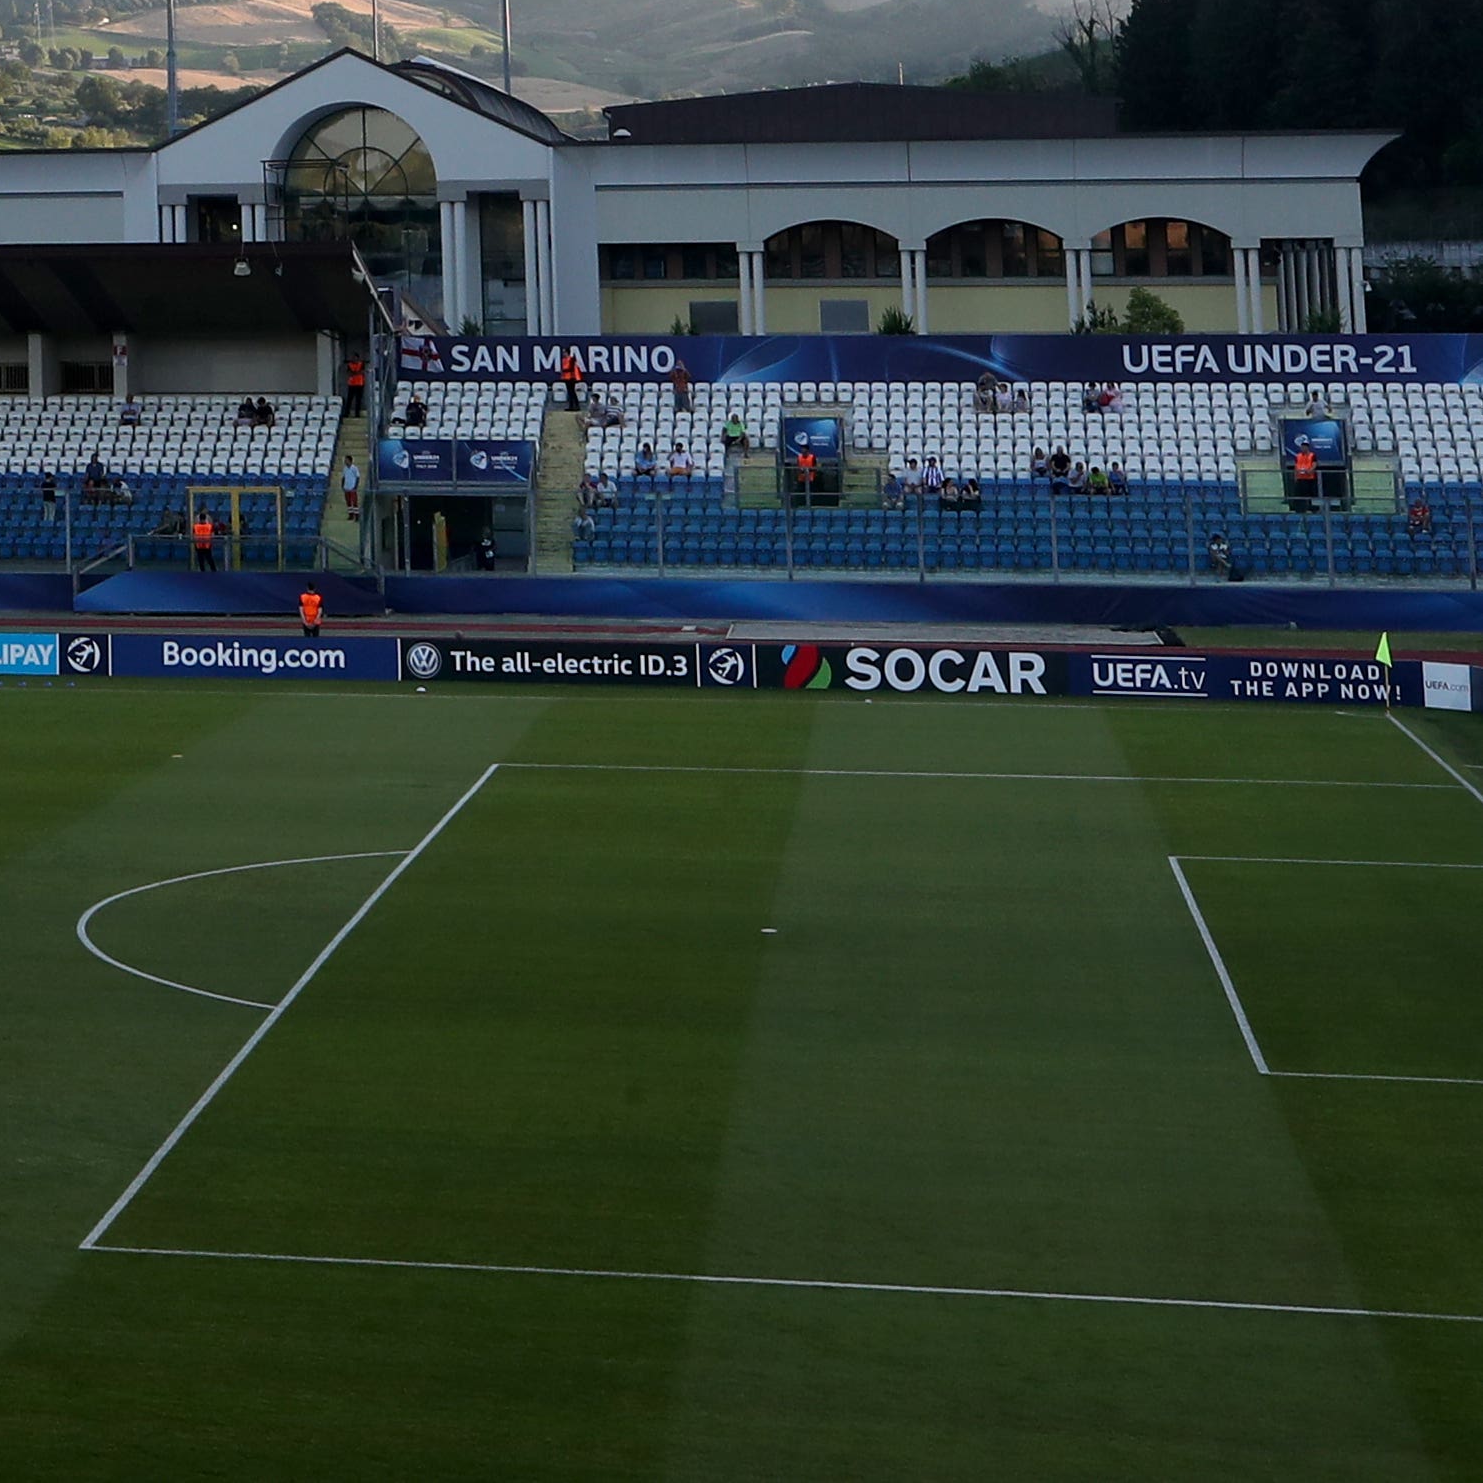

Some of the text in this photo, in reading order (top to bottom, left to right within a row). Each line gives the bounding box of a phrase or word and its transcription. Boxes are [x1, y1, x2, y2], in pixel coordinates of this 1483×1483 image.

[450, 344, 676, 374] SAN MARINO
[1121, 344, 1417, 374] UEFA UNDER-21
[162, 641, 346, 674] Booking.com
[449, 651, 688, 676] The all-electric ID.3
[844, 647, 1047, 696] SOCAR
[1249, 661, 1381, 680] DOWNLOAD
[1092, 663, 1206, 690] UEFA.tv
[1230, 680, 1402, 702] THE APP NOW!
